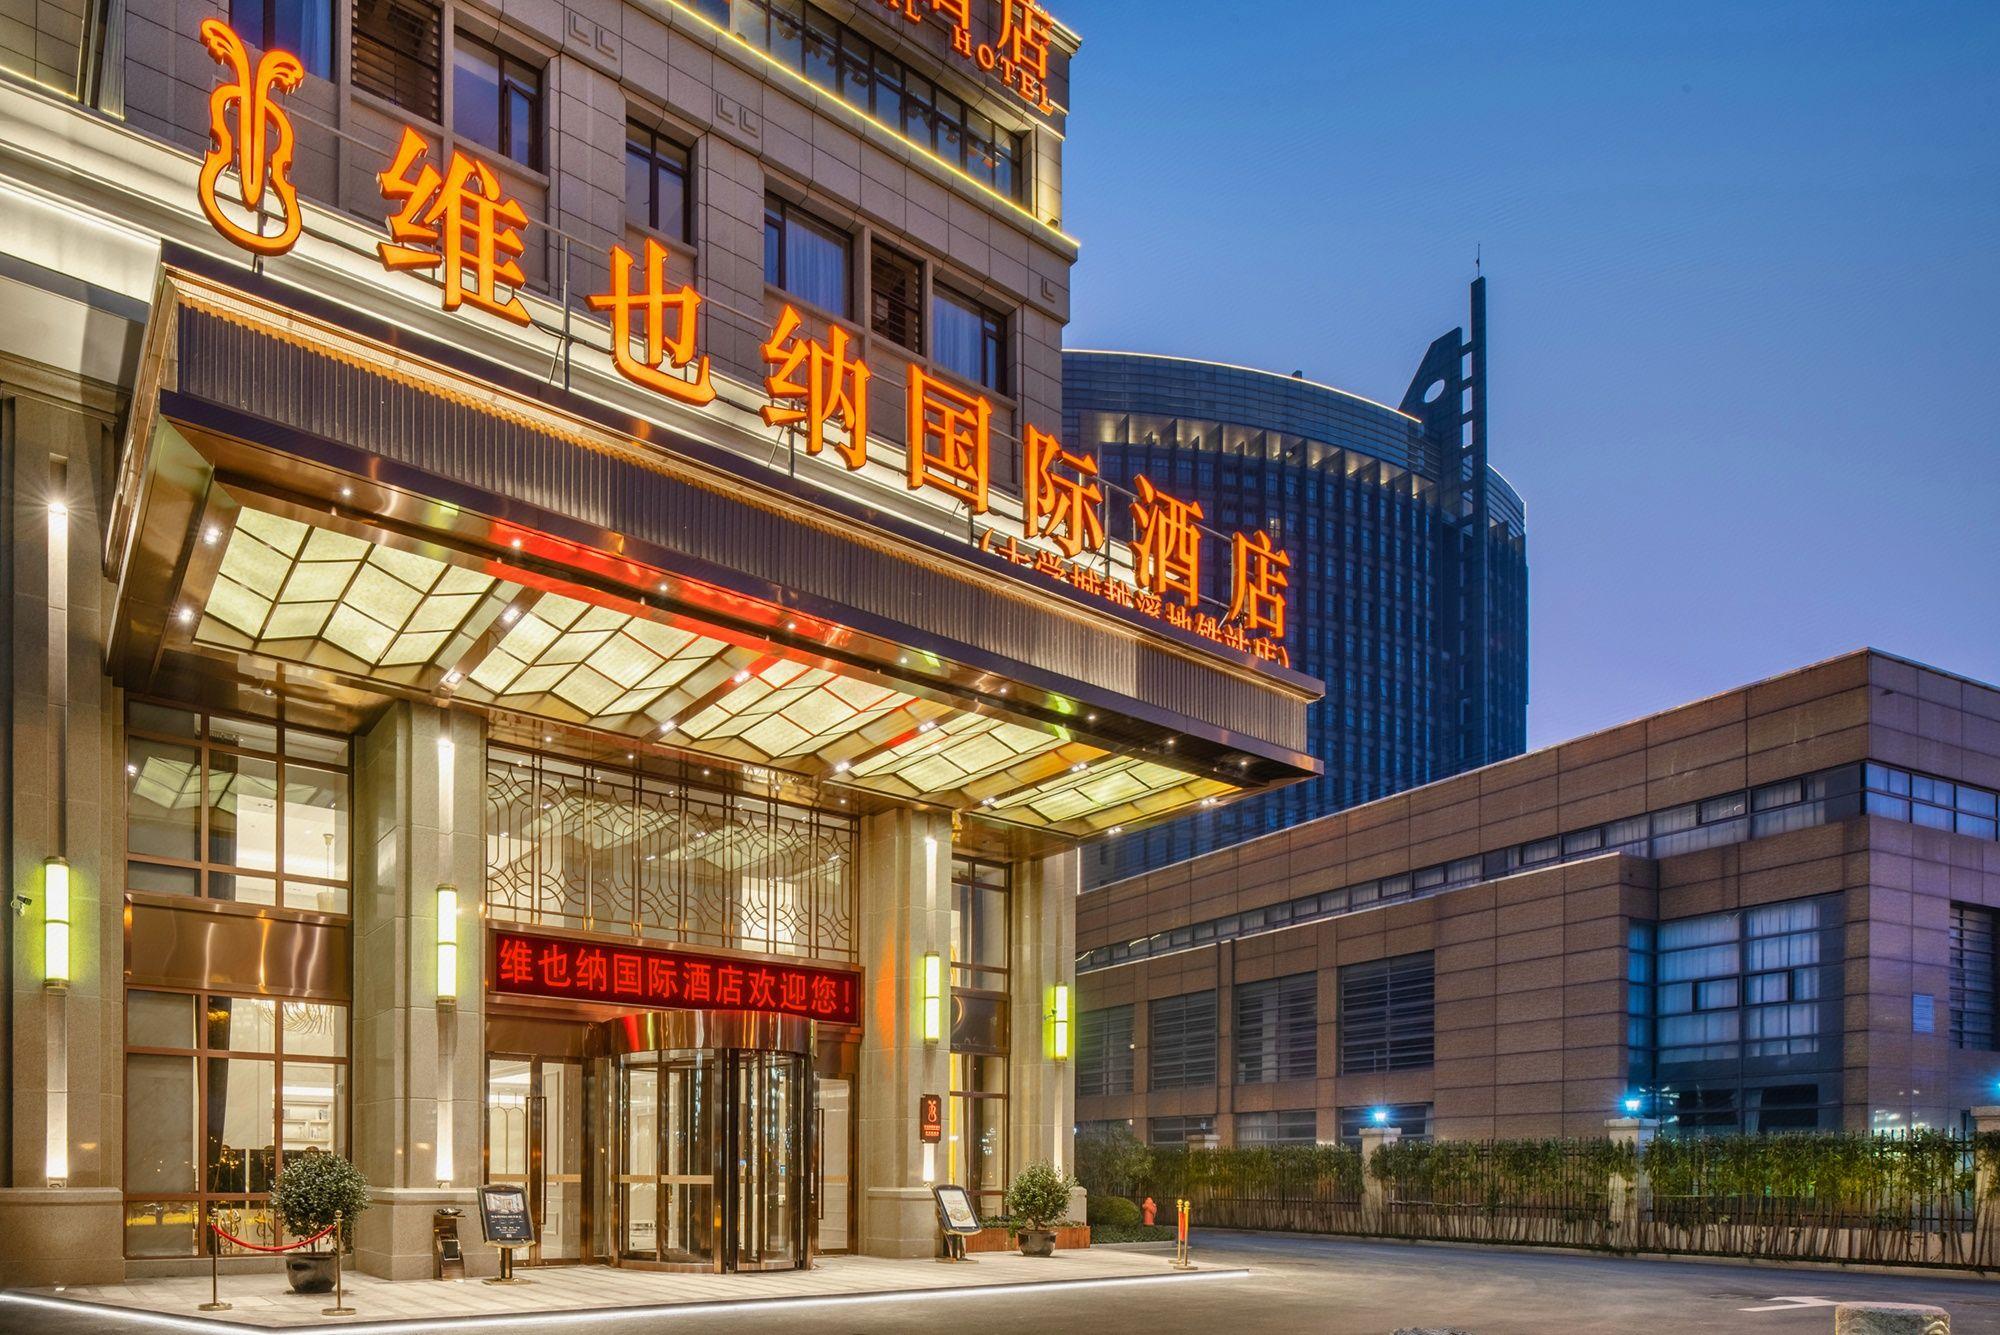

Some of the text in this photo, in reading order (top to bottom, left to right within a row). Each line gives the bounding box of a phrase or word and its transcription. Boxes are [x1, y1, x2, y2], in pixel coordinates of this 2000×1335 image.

[952, 24, 1054, 116] HOTEL
[376, 126, 1292, 639] 维也纳国际酒店
[499, 939, 851, 1014] 维也纳国际酒店欢迎您！
